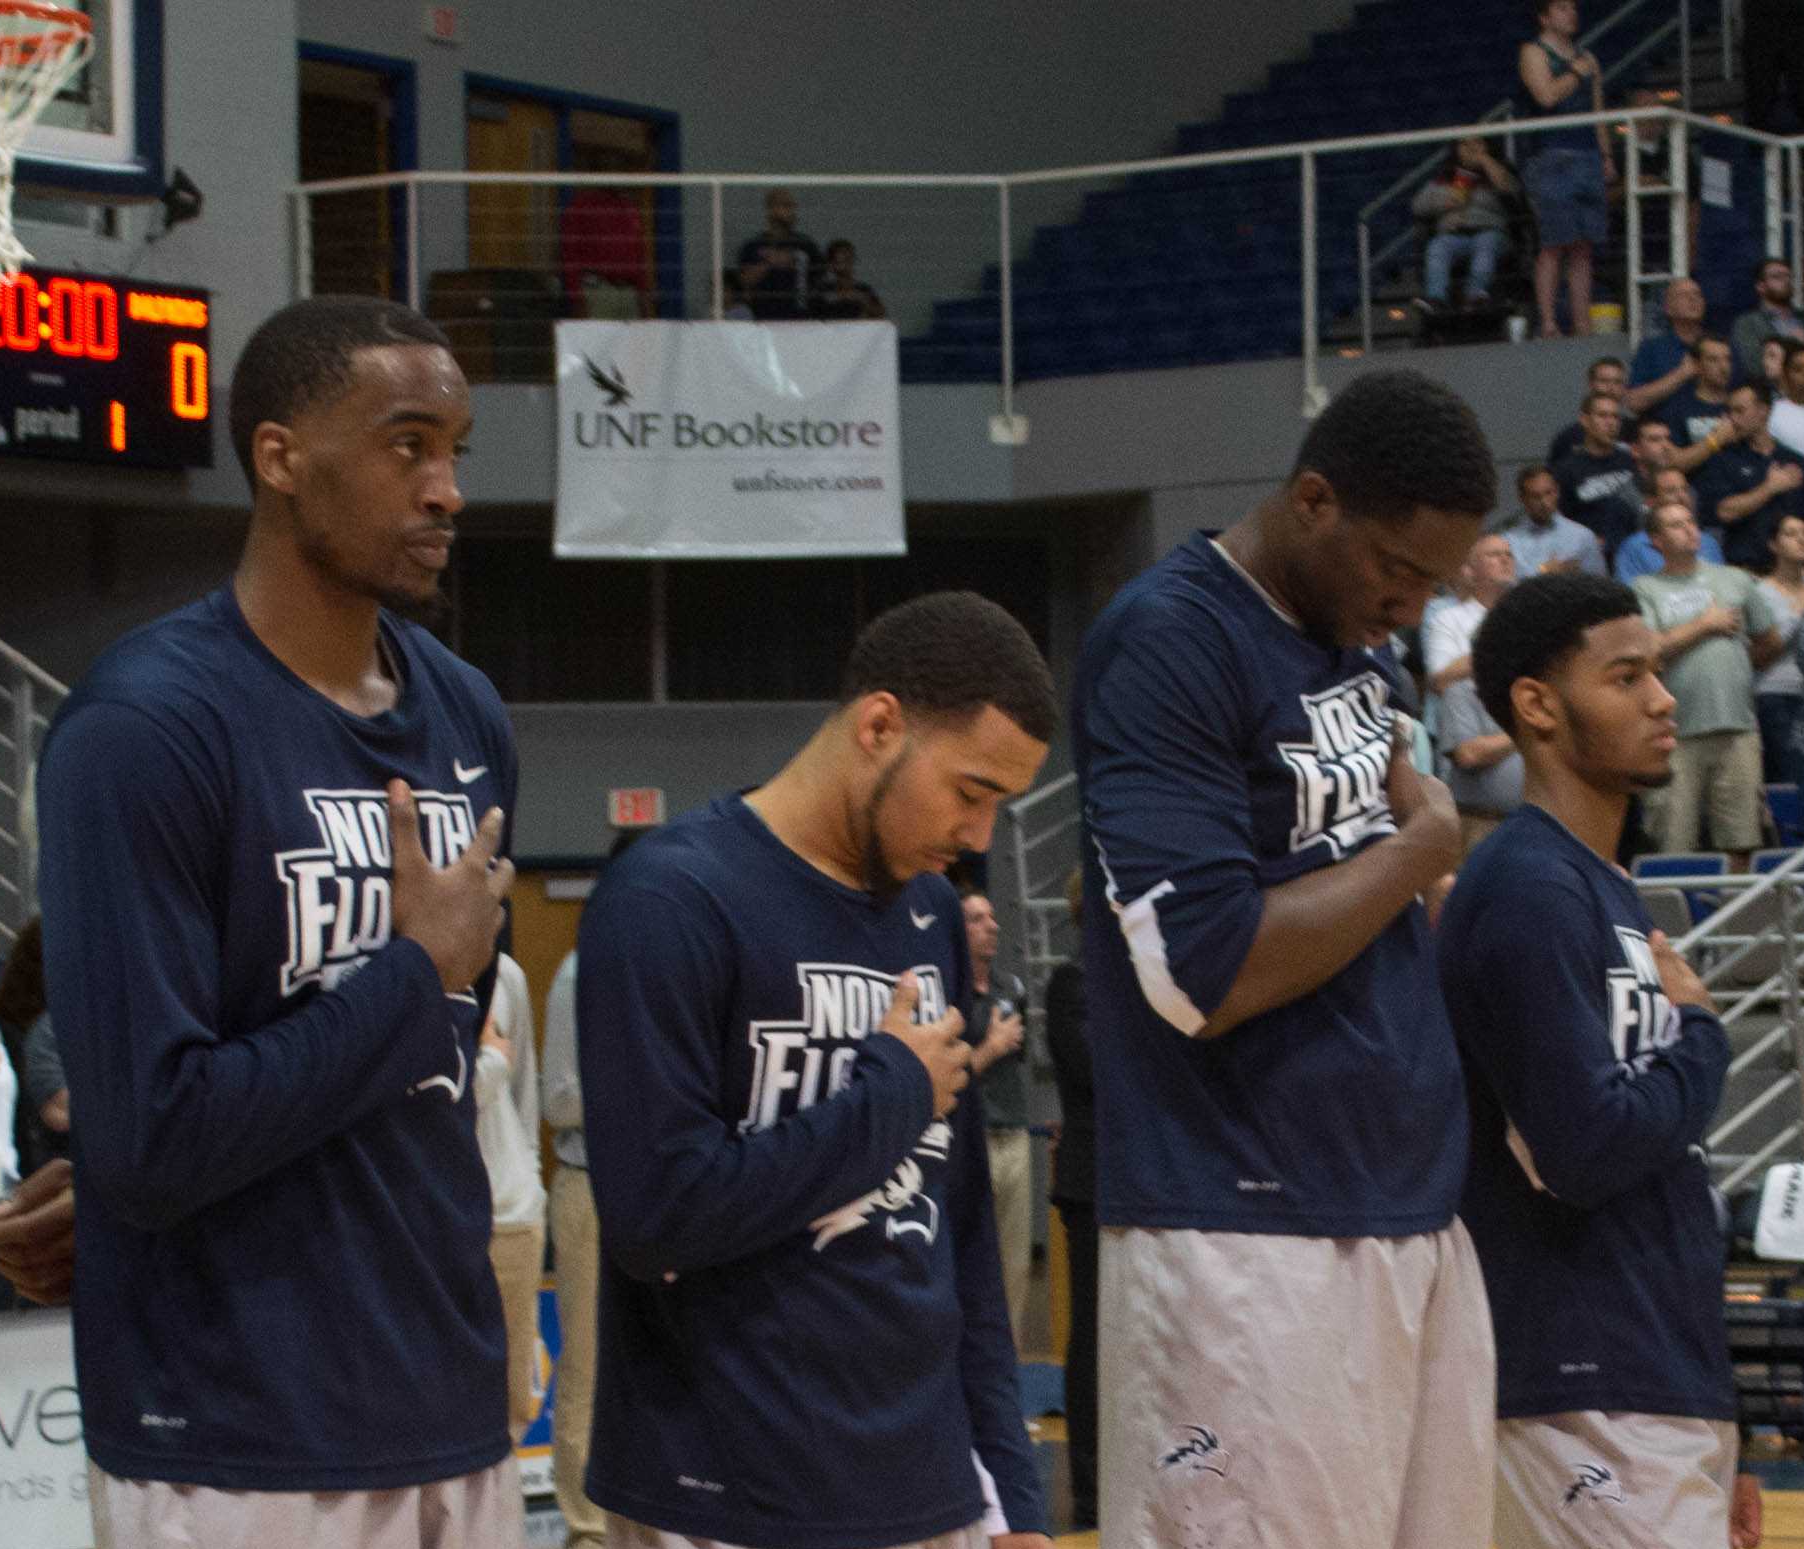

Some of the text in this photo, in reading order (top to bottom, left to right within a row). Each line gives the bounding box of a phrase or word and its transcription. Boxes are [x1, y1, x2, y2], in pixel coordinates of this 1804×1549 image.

[171, 342, 208, 420] 0
[574, 412, 884, 449] UNF Bookstore
[732, 469, 884, 493] unfstore.com
